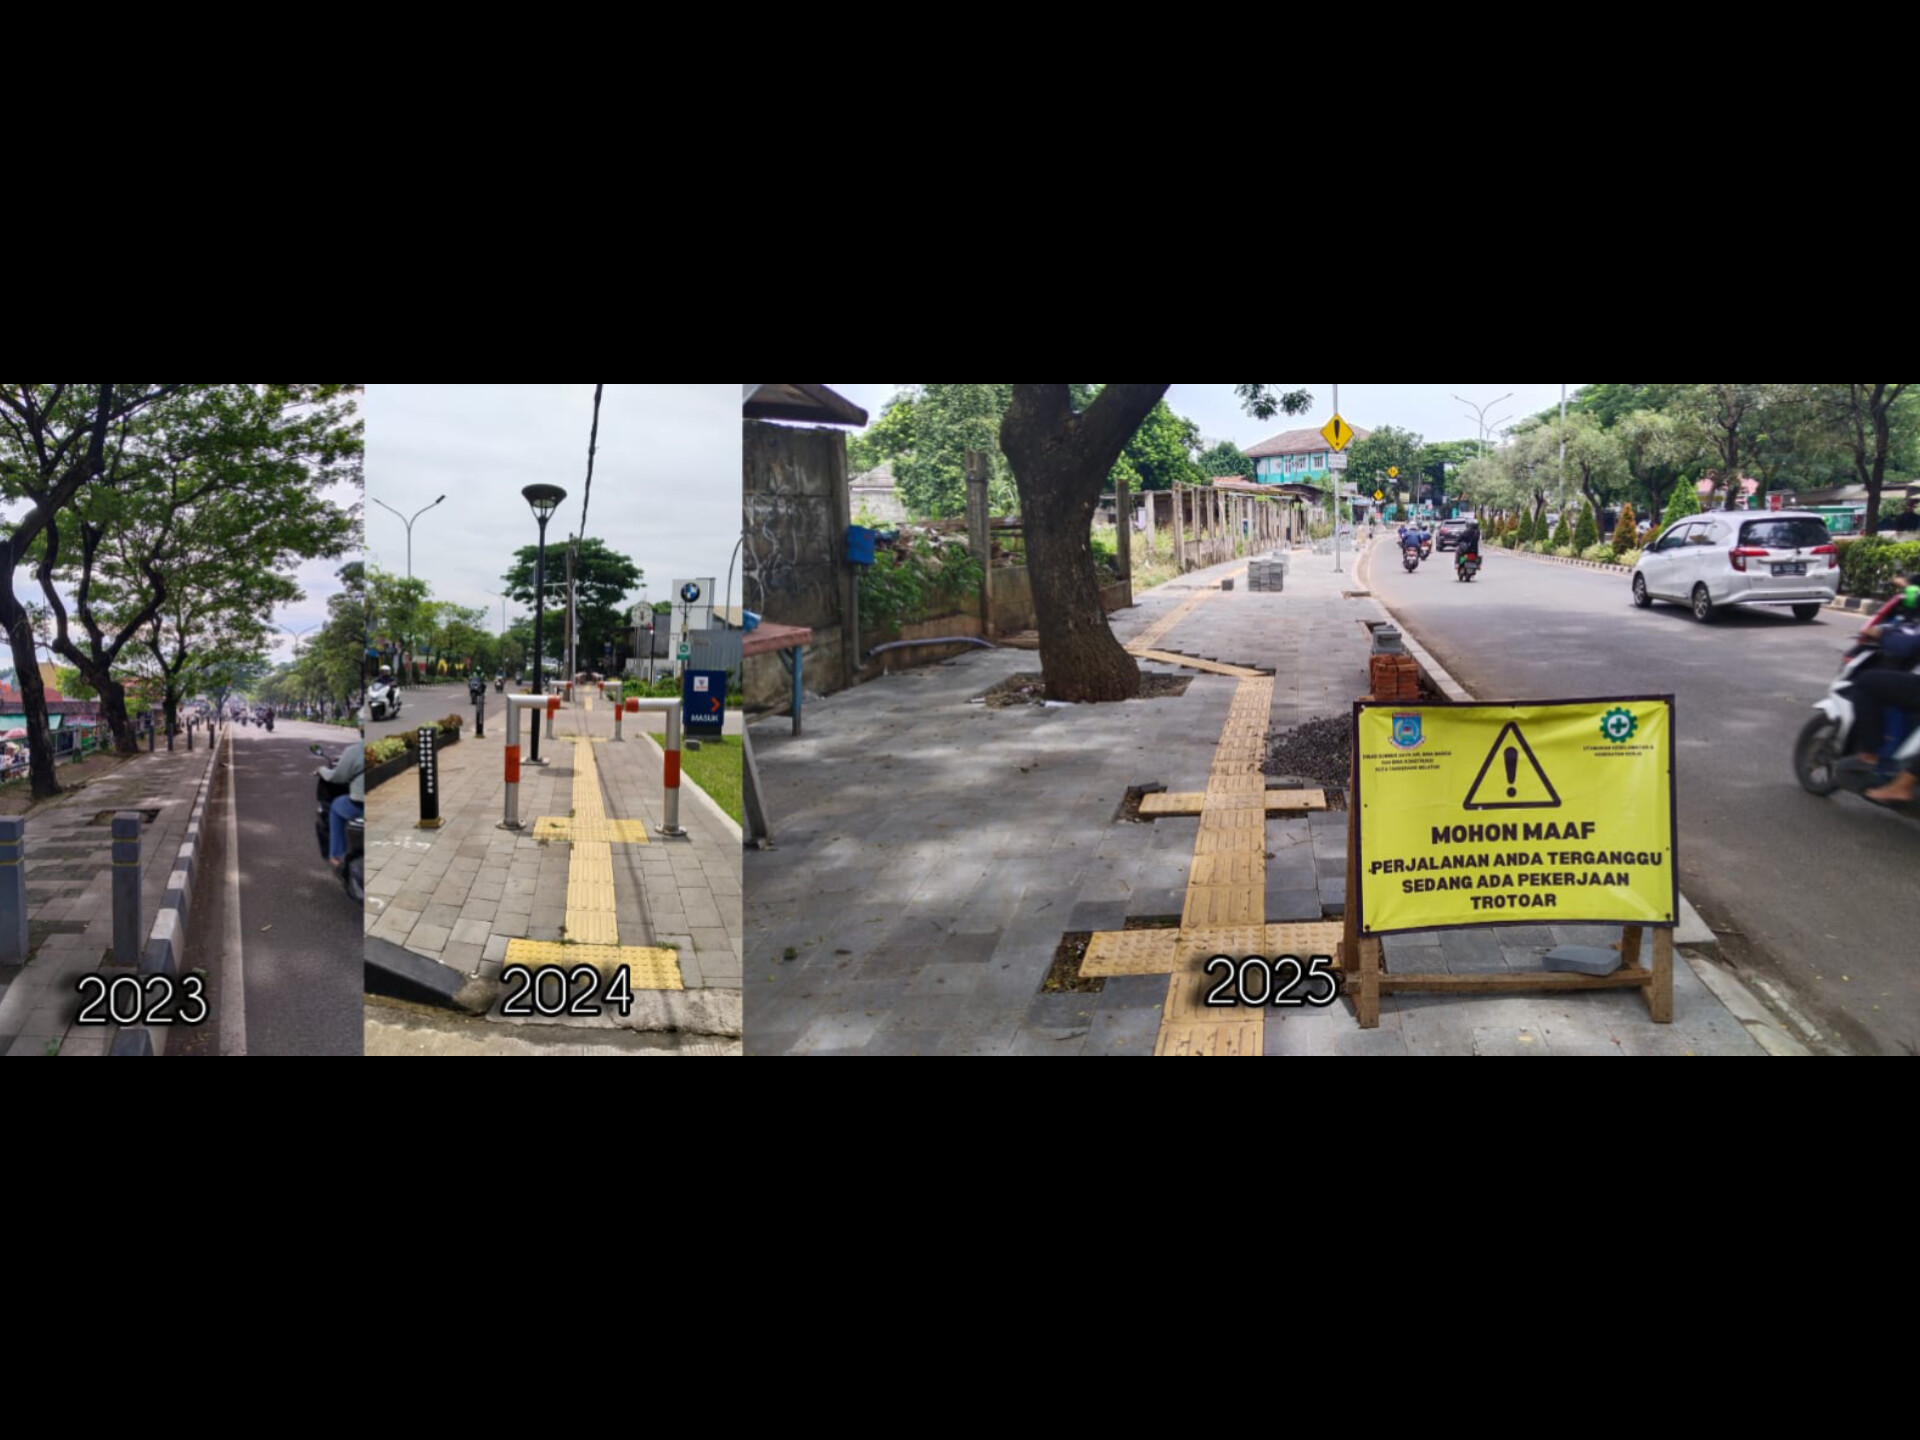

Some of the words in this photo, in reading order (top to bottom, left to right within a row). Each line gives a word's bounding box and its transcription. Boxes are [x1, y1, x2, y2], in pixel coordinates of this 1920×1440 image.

[691, 713, 719, 722] MASUK
[1431, 823, 1518, 845] MOHON
[1522, 821, 1596, 841] MAAF
[1371, 853, 1489, 875] PERJALANAN
[1493, 851, 1544, 867] ANDA
[1547, 851, 1662, 866] TERGANGGU
[1402, 876, 1473, 893] SEDANG
[1476, 873, 1514, 888] ADA
[1517, 872, 1629, 887] PEKERJAAN
[1470, 893, 1557, 910] TROTOAR
